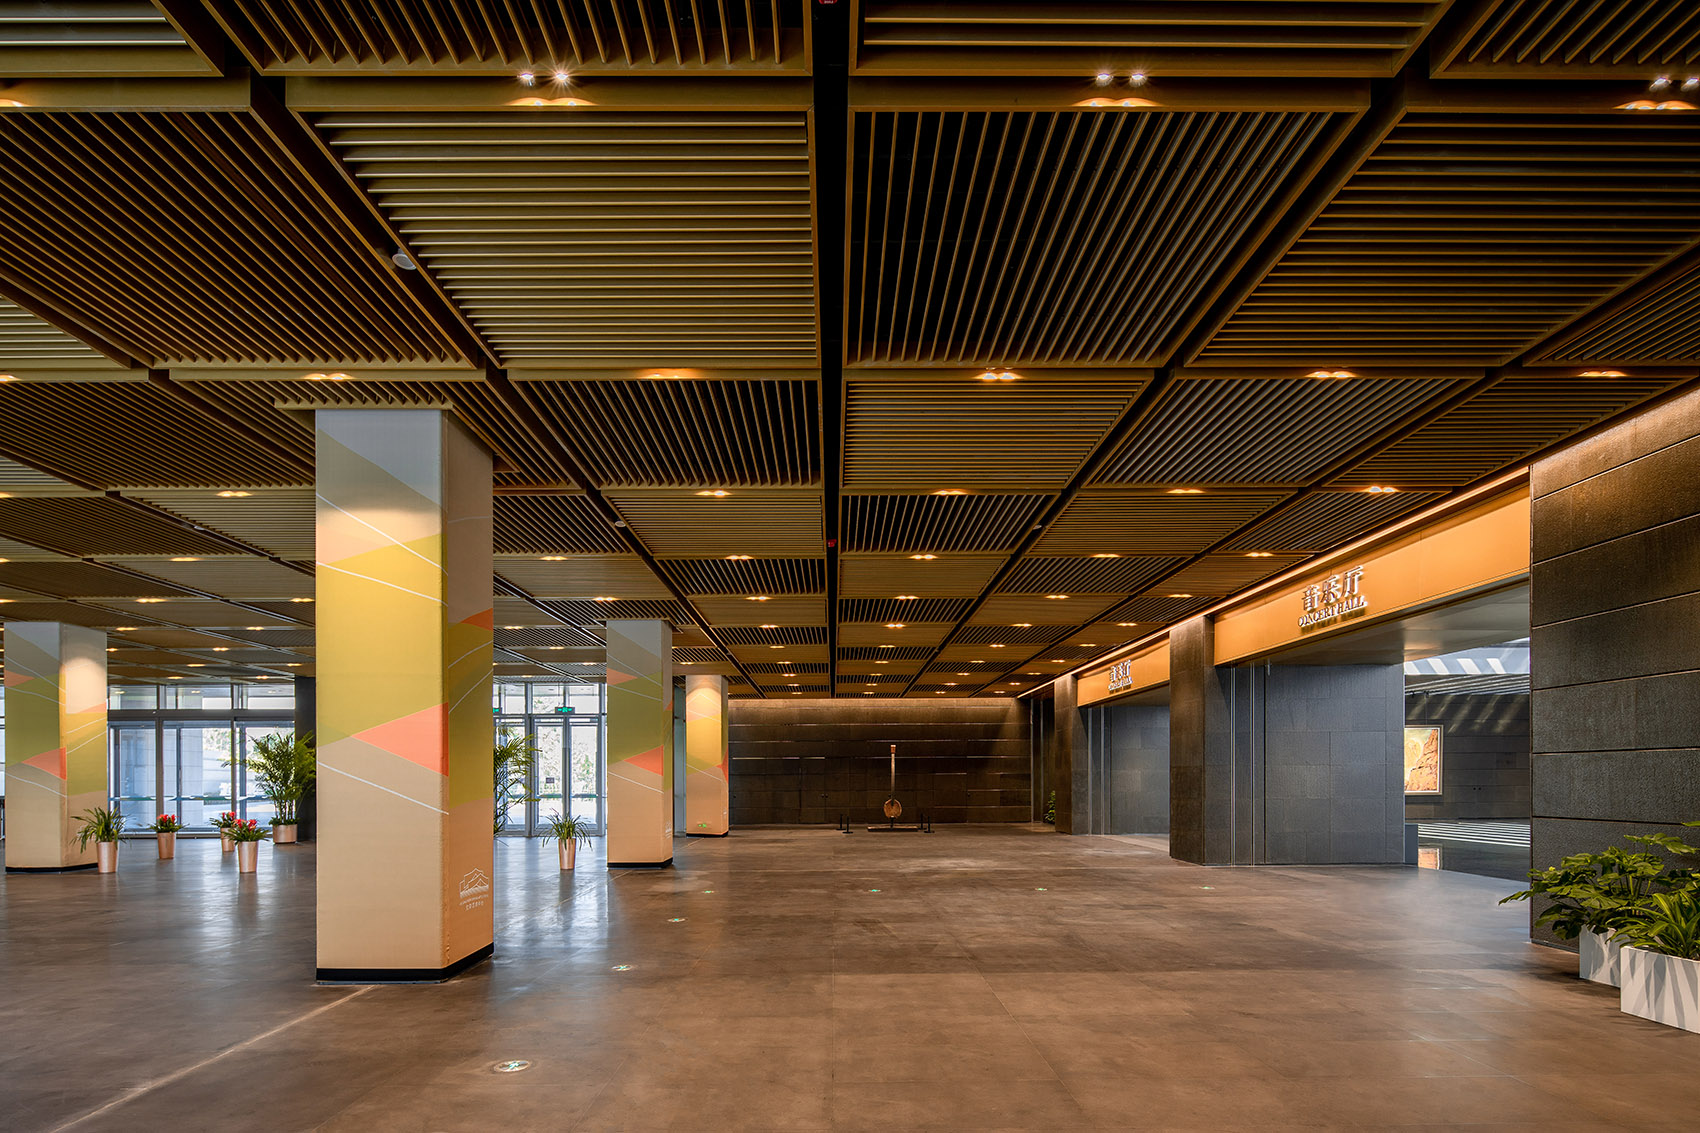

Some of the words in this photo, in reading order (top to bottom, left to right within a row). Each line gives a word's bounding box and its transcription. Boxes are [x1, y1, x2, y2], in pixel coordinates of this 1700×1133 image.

[1301, 565, 1364, 611] 音乐厅
[1298, 605, 1336, 627] CONCERT
[1336, 595, 1368, 615] HALL
